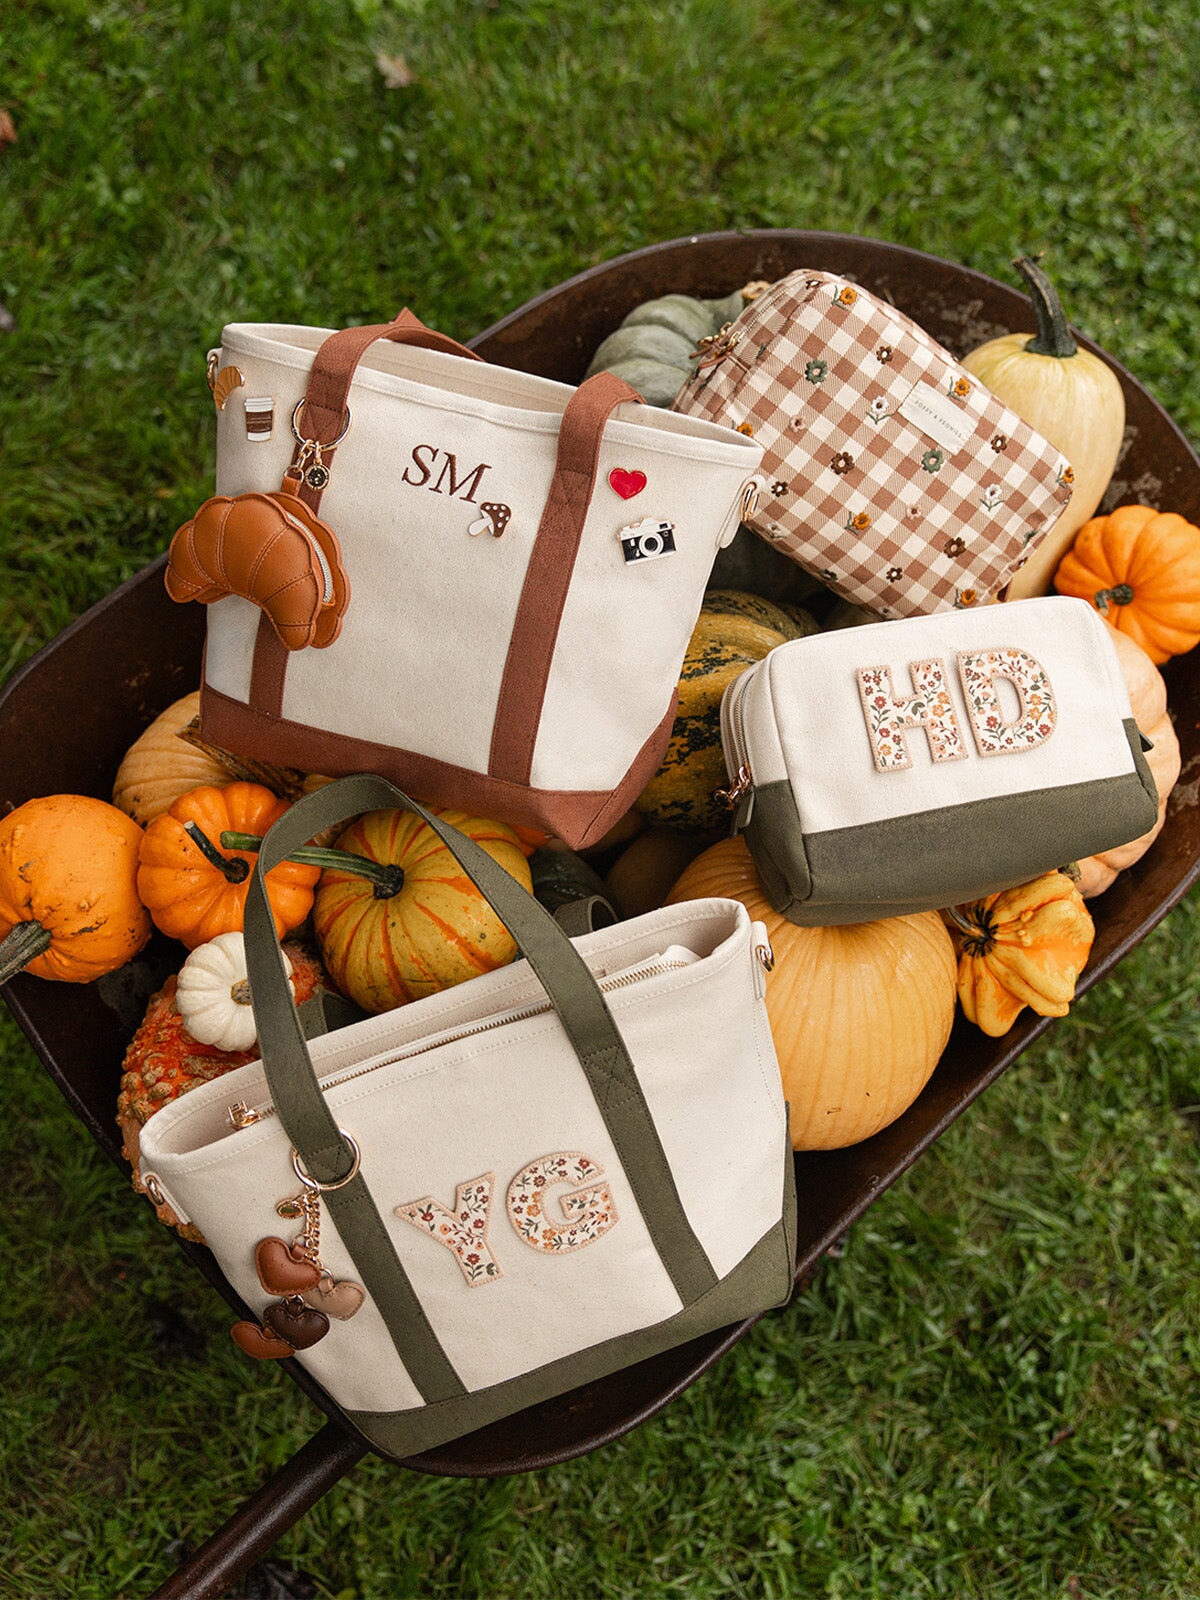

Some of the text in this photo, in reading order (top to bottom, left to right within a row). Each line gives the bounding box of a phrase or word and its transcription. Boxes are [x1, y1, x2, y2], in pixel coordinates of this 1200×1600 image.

[914, 400, 933, 414] POPPY
[938, 418, 962, 438] PEONIES
[401, 444, 493, 504] SM
[855, 646, 1058, 773] HD
[393, 1150, 620, 1288] YG
